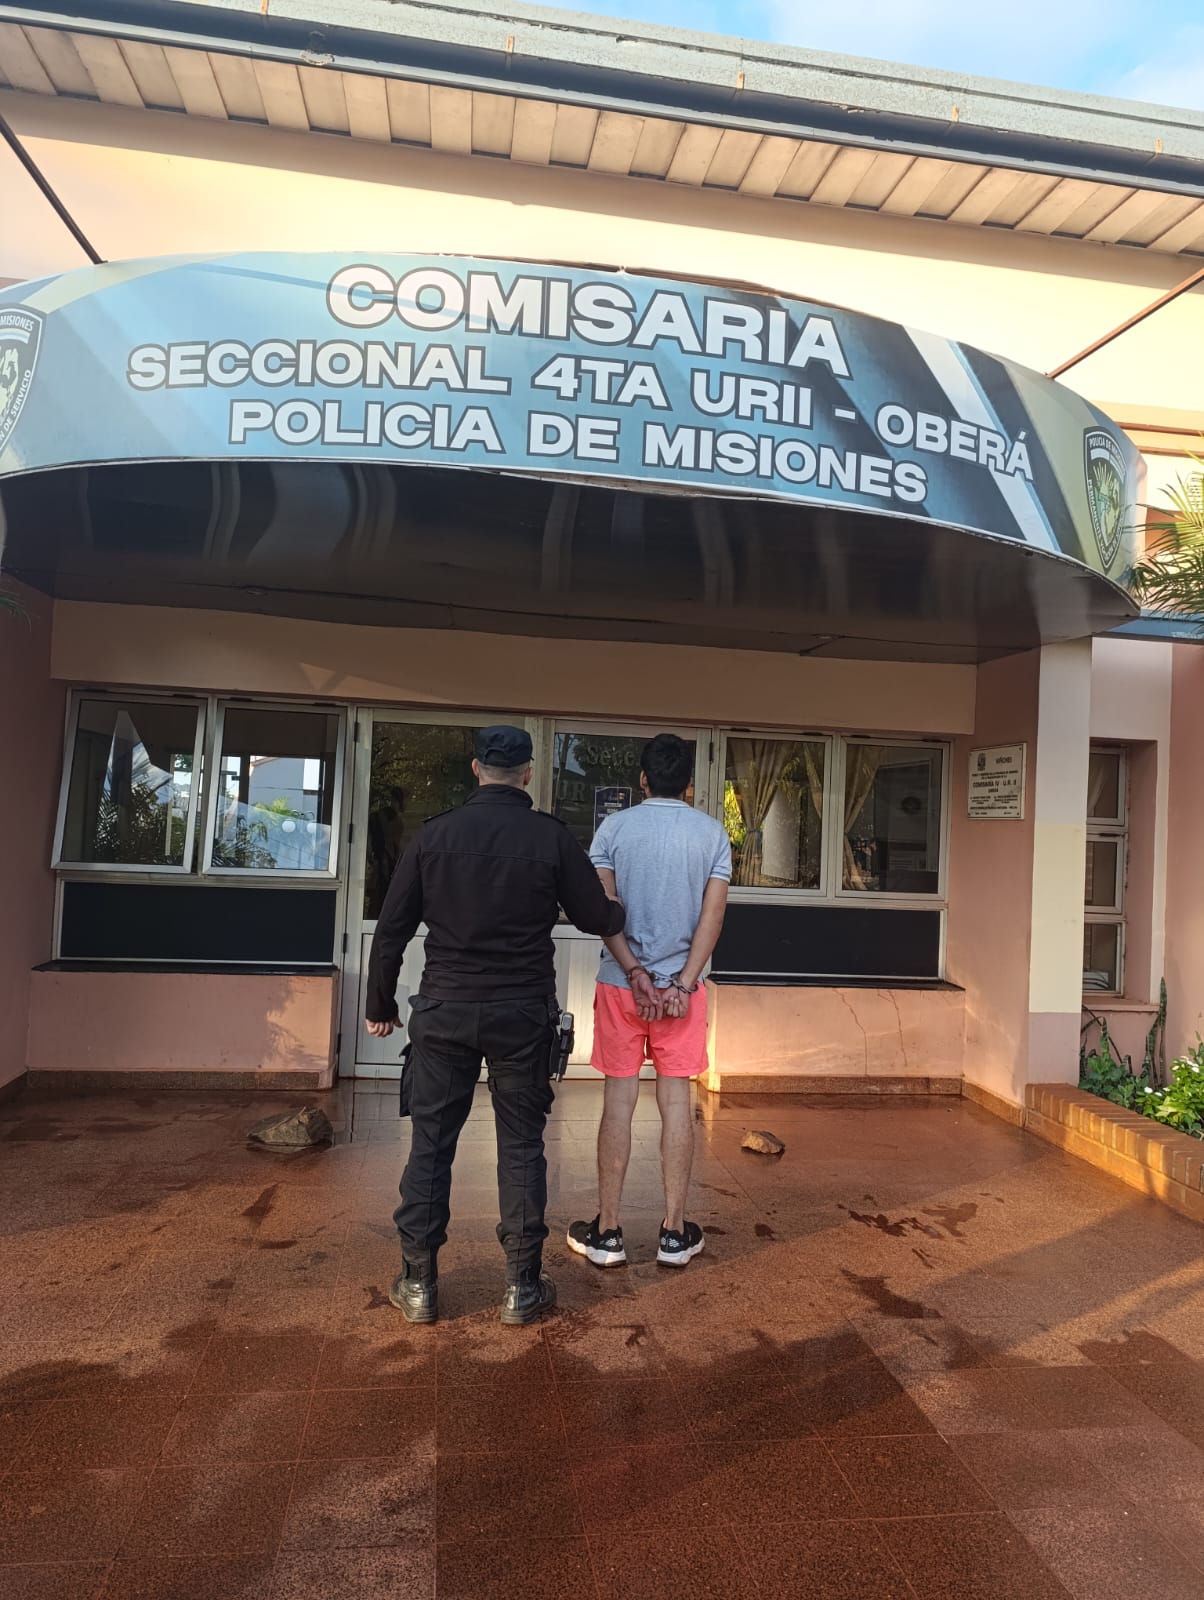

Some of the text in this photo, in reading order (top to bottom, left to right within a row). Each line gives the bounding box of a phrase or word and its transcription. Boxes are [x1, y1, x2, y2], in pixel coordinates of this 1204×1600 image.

[0, 315, 34, 331] MISIONES
[328, 264, 851, 379] COMISARIA
[10, 369, 31, 416] SERVICIO
[127, 339, 1033, 481] SECCIONAL 4TA URII - OBERÁ
[228, 398, 928, 504] POLICIA DE MISIONES
